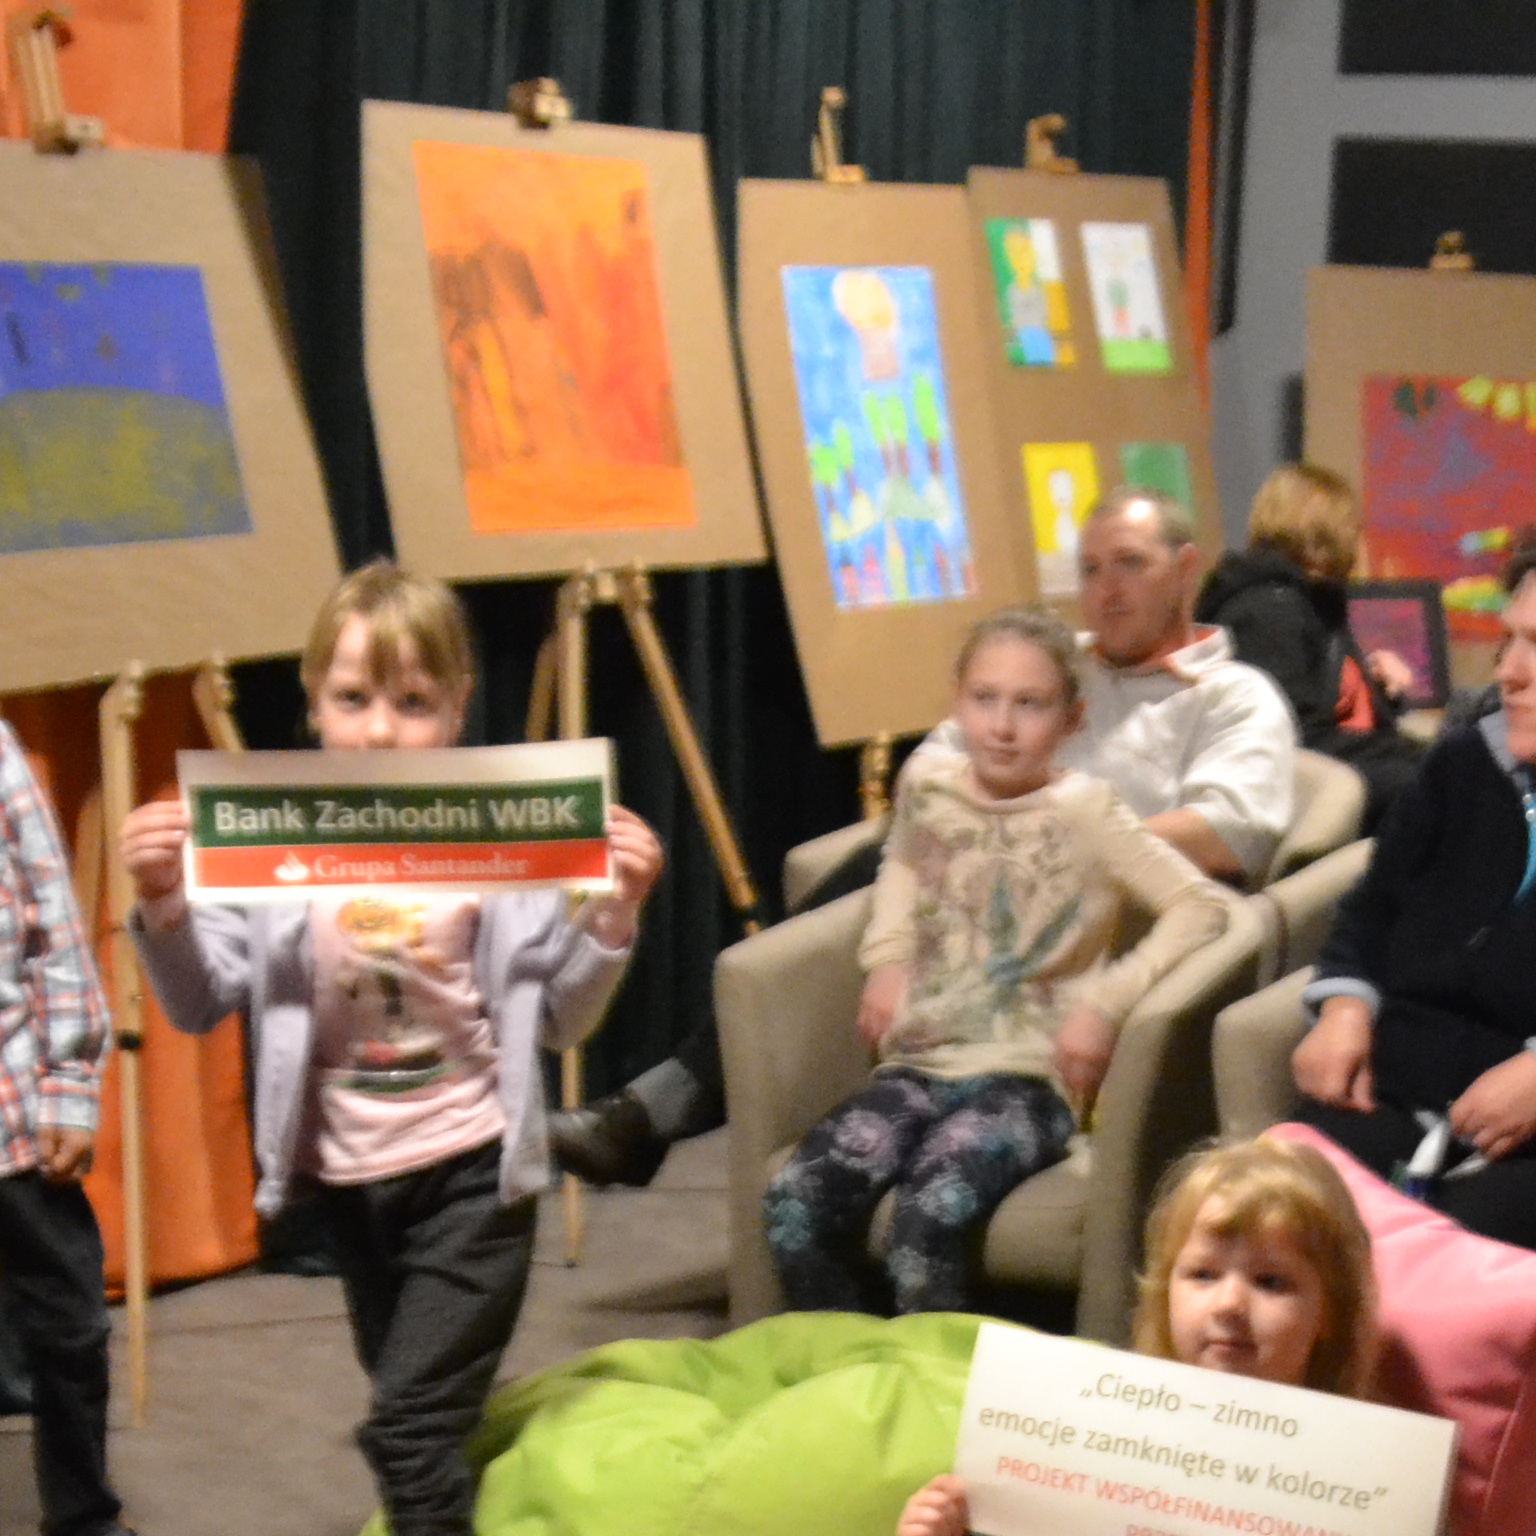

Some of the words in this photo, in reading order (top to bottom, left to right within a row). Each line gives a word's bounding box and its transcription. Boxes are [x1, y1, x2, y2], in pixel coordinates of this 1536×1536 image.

[214, 801, 304, 833] Bank
[315, 798, 480, 831] Zachodni
[487, 795, 582, 828] WBK
[313, 854, 396, 881] Grupa
[399, 852, 529, 877] Santander
[1212, 1399, 1299, 1438] zimno
[978, 1406, 1077, 1447] emocje
[1083, 1428, 1226, 1479] zamknięte
[1233, 1464, 1261, 1486] w
[995, 1456, 1090, 1496] PROJEKT
